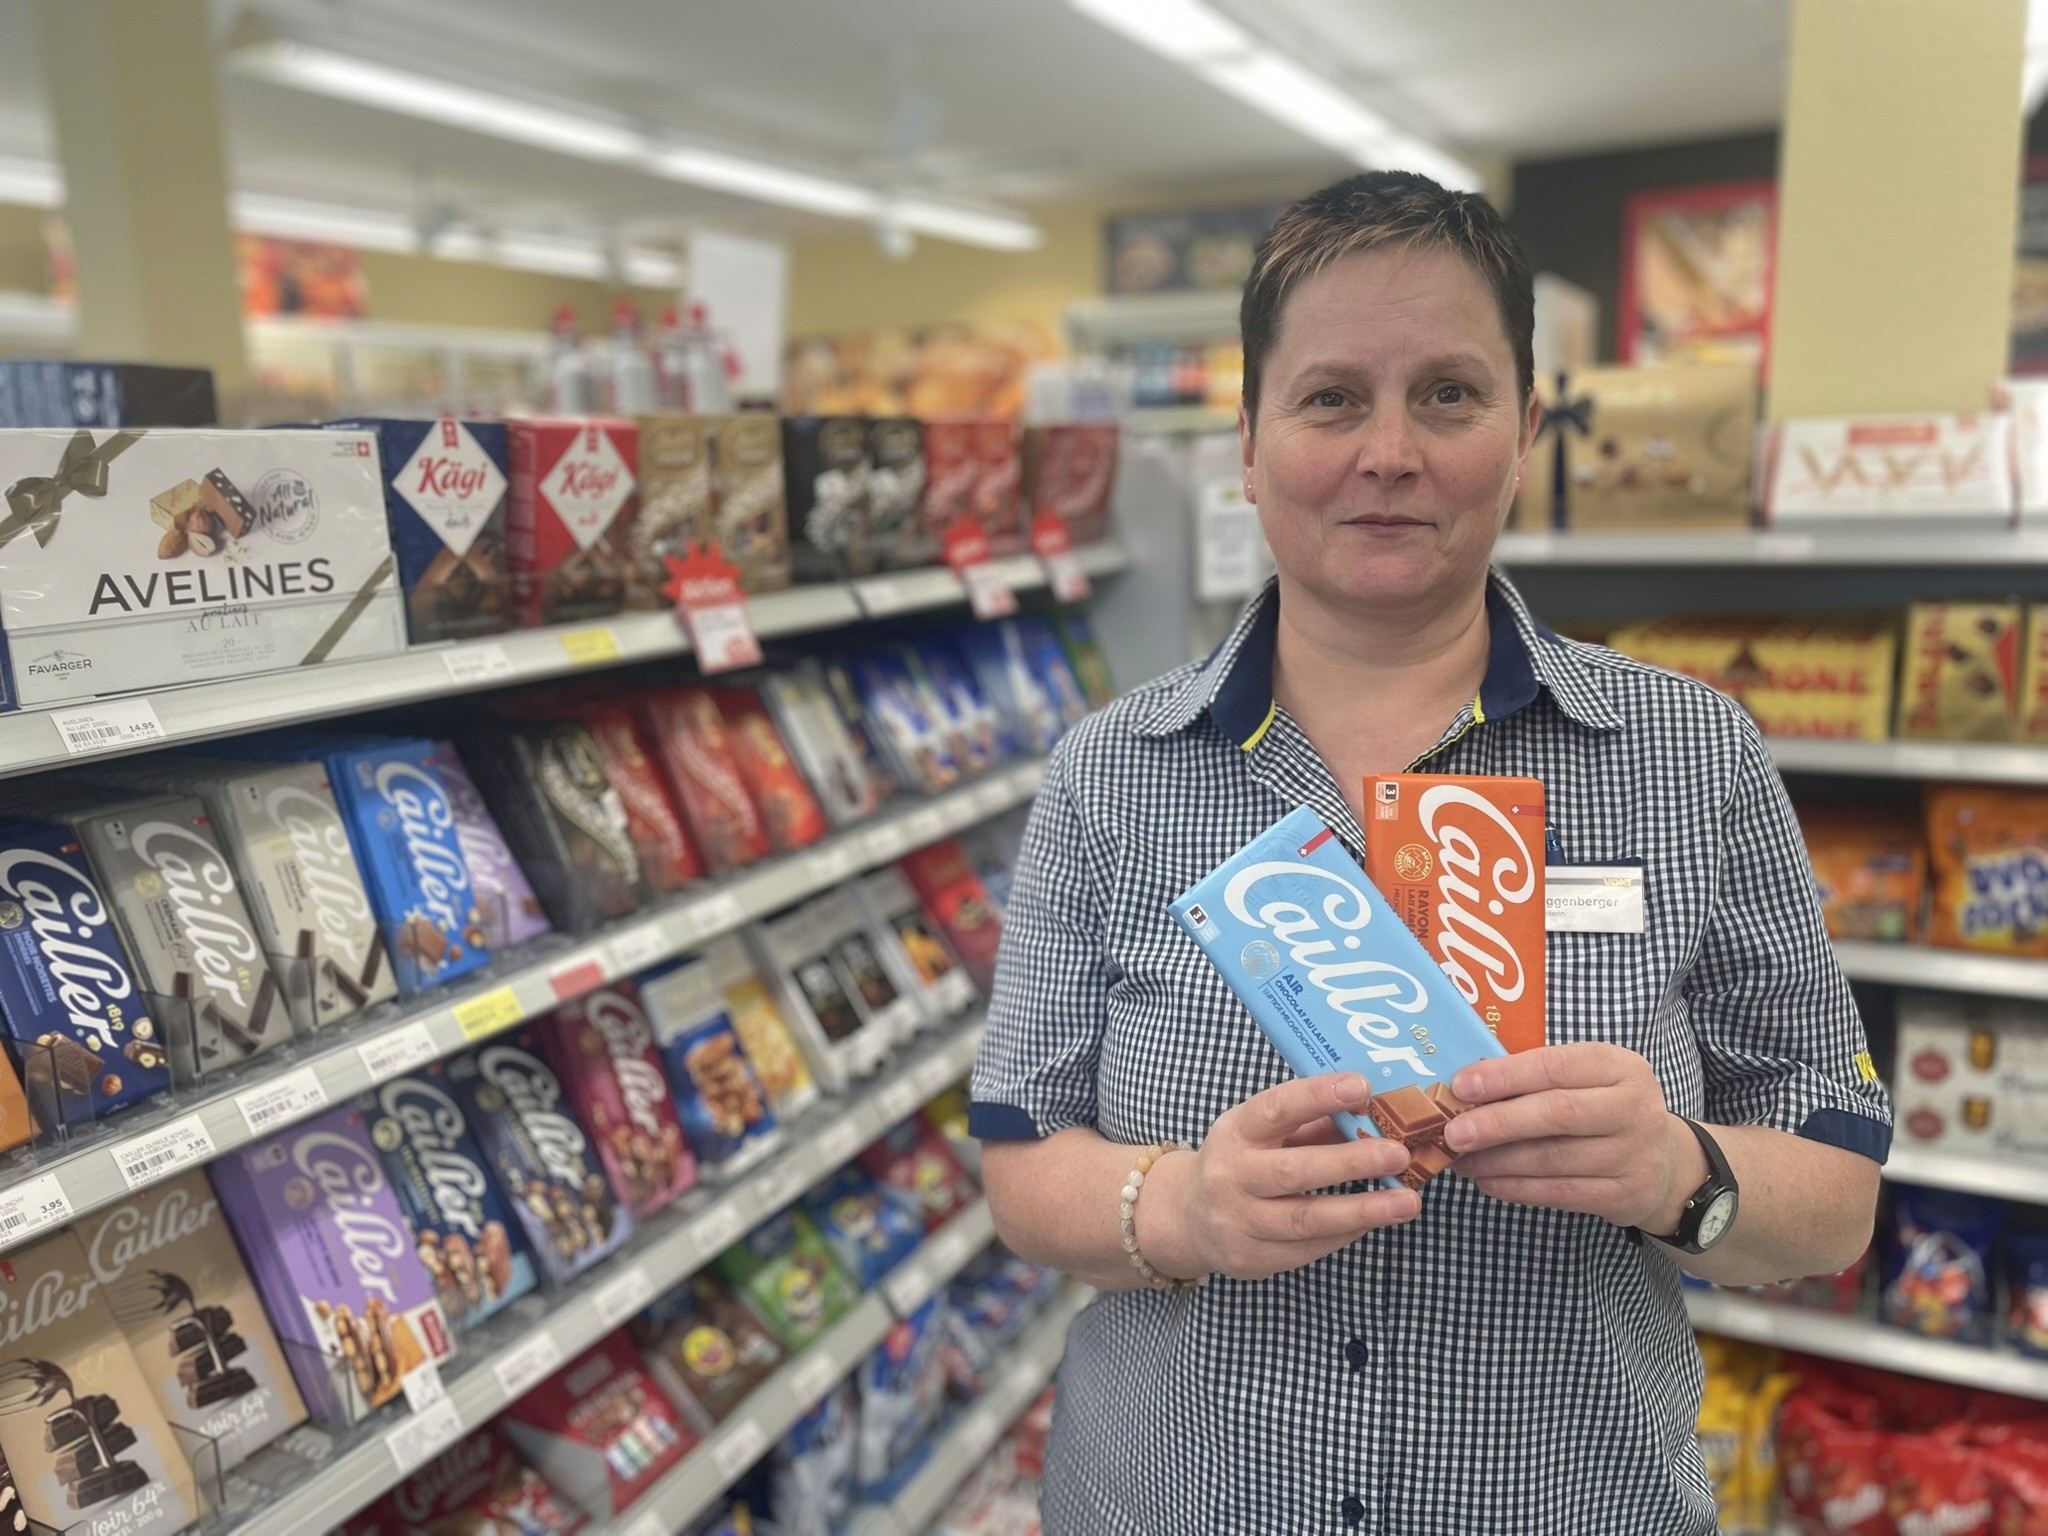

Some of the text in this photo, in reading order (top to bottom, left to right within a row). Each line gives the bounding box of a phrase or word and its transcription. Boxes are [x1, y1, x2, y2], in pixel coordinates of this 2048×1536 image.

[272, 482, 292, 501] All
[417, 456, 488, 499] Kägi
[259, 487, 315, 528] Natural
[88, 557, 335, 616] AVELINES
[187, 612, 262, 633] AU LAIT
[28, 658, 93, 676] FAVARGER
[62, 716, 94, 726] AVELINES
[128, 721, 155, 733] 14.95
[376, 761, 468, 931] Cailler
[1421, 861, 1432, 877] LAIT
[265, 786, 370, 964] Cailler
[1408, 888, 1416, 907] LAIT
[1417, 784, 1536, 1006] Caille
[131, 821, 257, 1008] Cailler
[1192, 910, 1202, 920] 3
[1417, 889, 1430, 939] RAYON
[0, 848, 132, 1048] Cailler
[22, 931, 38, 955] NOIR
[32, 955, 57, 1003] NOISETTES
[1223, 861, 1436, 1078] Cailler
[1282, 973, 1304, 997] AIR
[106, 1003, 125, 1032] 1819
[1262, 988, 1284, 1013] LUFTIGE
[1280, 1010, 1327, 1069] MILCHSCHOKOLADE
[1275, 980, 1342, 1063] CHOCOLAT AU LAIT AÉRÉ
[1409, 1023, 1437, 1055] 1819
[478, 1045, 587, 1191] Cailler
[185, 1137, 207, 1151] 3.95
[380, 1077, 488, 1241] Cailler
[39, 1198, 63, 1214] 3.95
[292, 1131, 404, 1305] Cailler
[88, 1188, 219, 1284] Cailler
